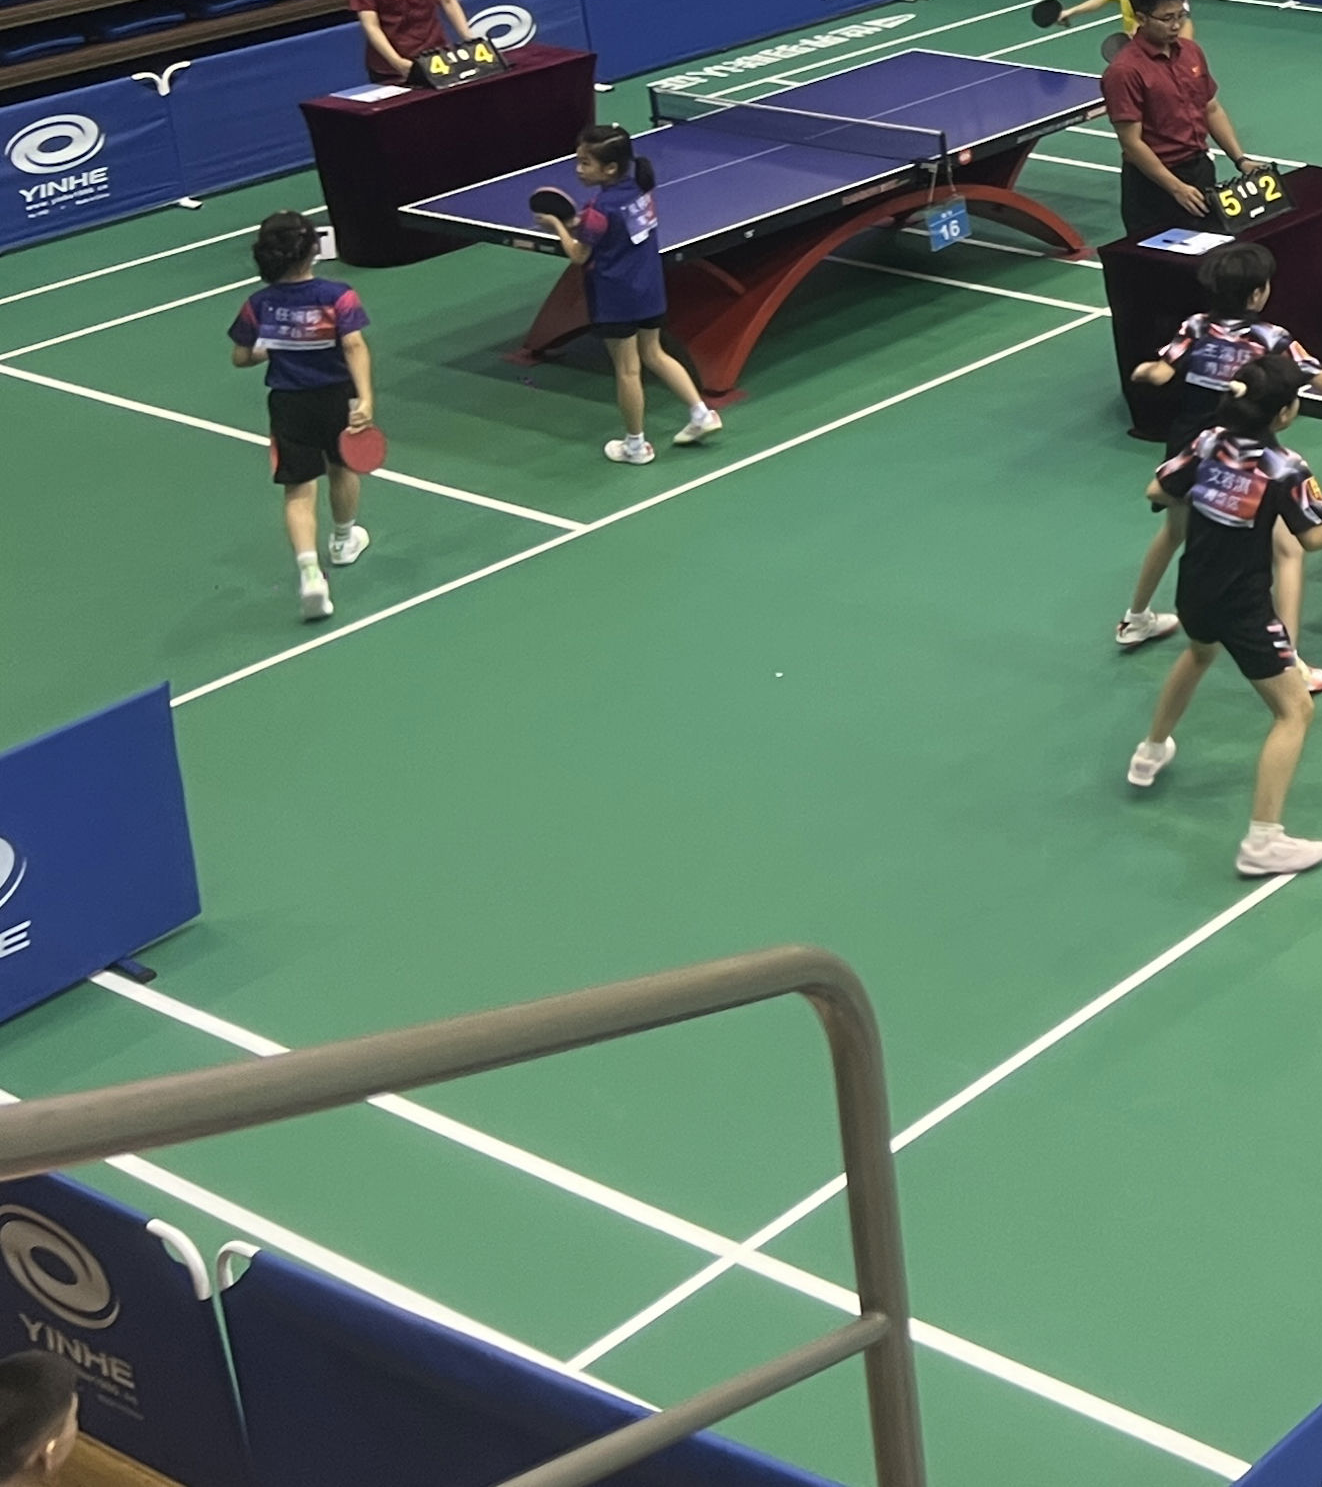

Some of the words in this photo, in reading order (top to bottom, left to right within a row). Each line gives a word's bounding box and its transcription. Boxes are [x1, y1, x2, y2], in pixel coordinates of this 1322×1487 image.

[431, 55, 450, 75] 4
[474, 43, 493, 63] 4
[19, 166, 109, 203] YINHE
[1219, 189, 1241, 216] 5
[1258, 175, 1281, 201] 2
[939, 219, 960, 241] 16
[19, 1313, 135, 1389] YINHE
